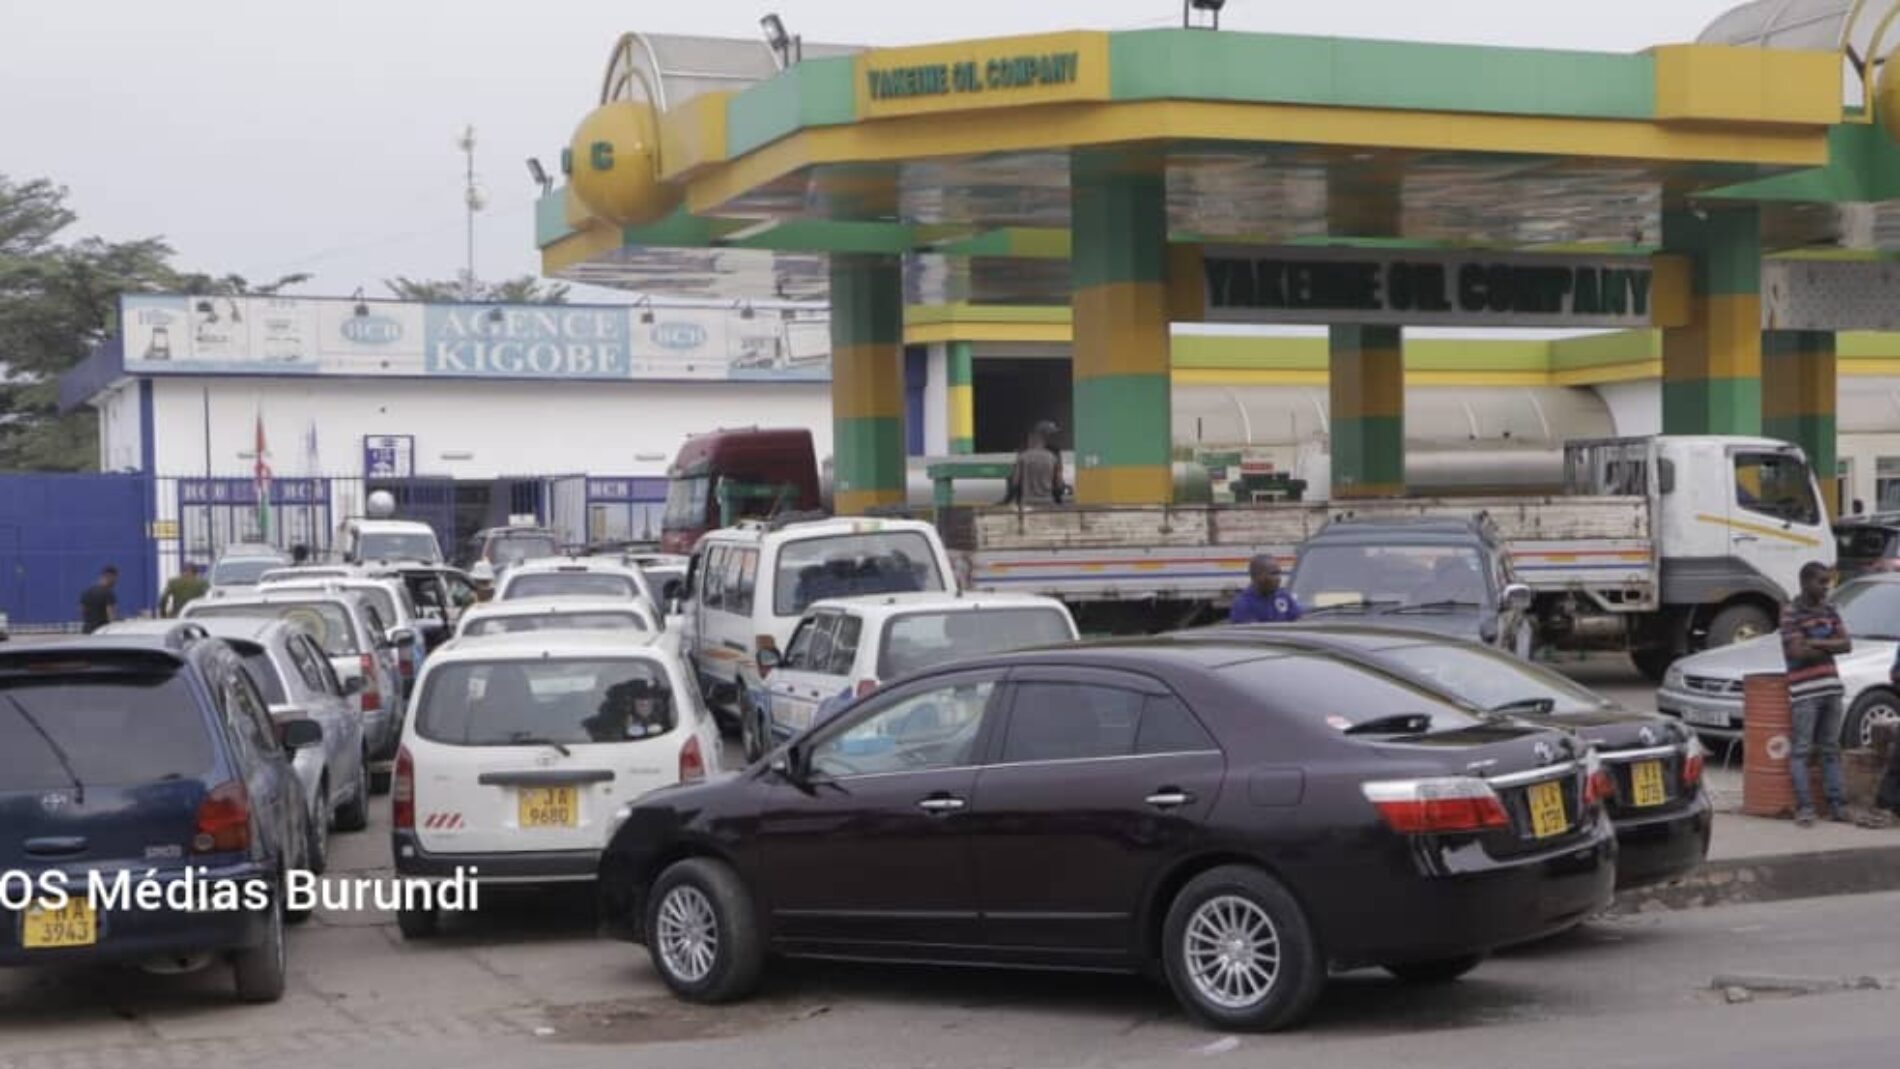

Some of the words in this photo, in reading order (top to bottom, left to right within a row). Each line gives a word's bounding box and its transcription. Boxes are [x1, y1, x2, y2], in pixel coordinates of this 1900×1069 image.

[953, 61, 983, 93] OIL
[986, 53, 1079, 89] COMPANY
[1387, 262, 1453, 312] OIL
[1458, 263, 1652, 317] COMPANY
[441, 308, 619, 340] AGENCE
[435, 341, 623, 373] KIGOBE
